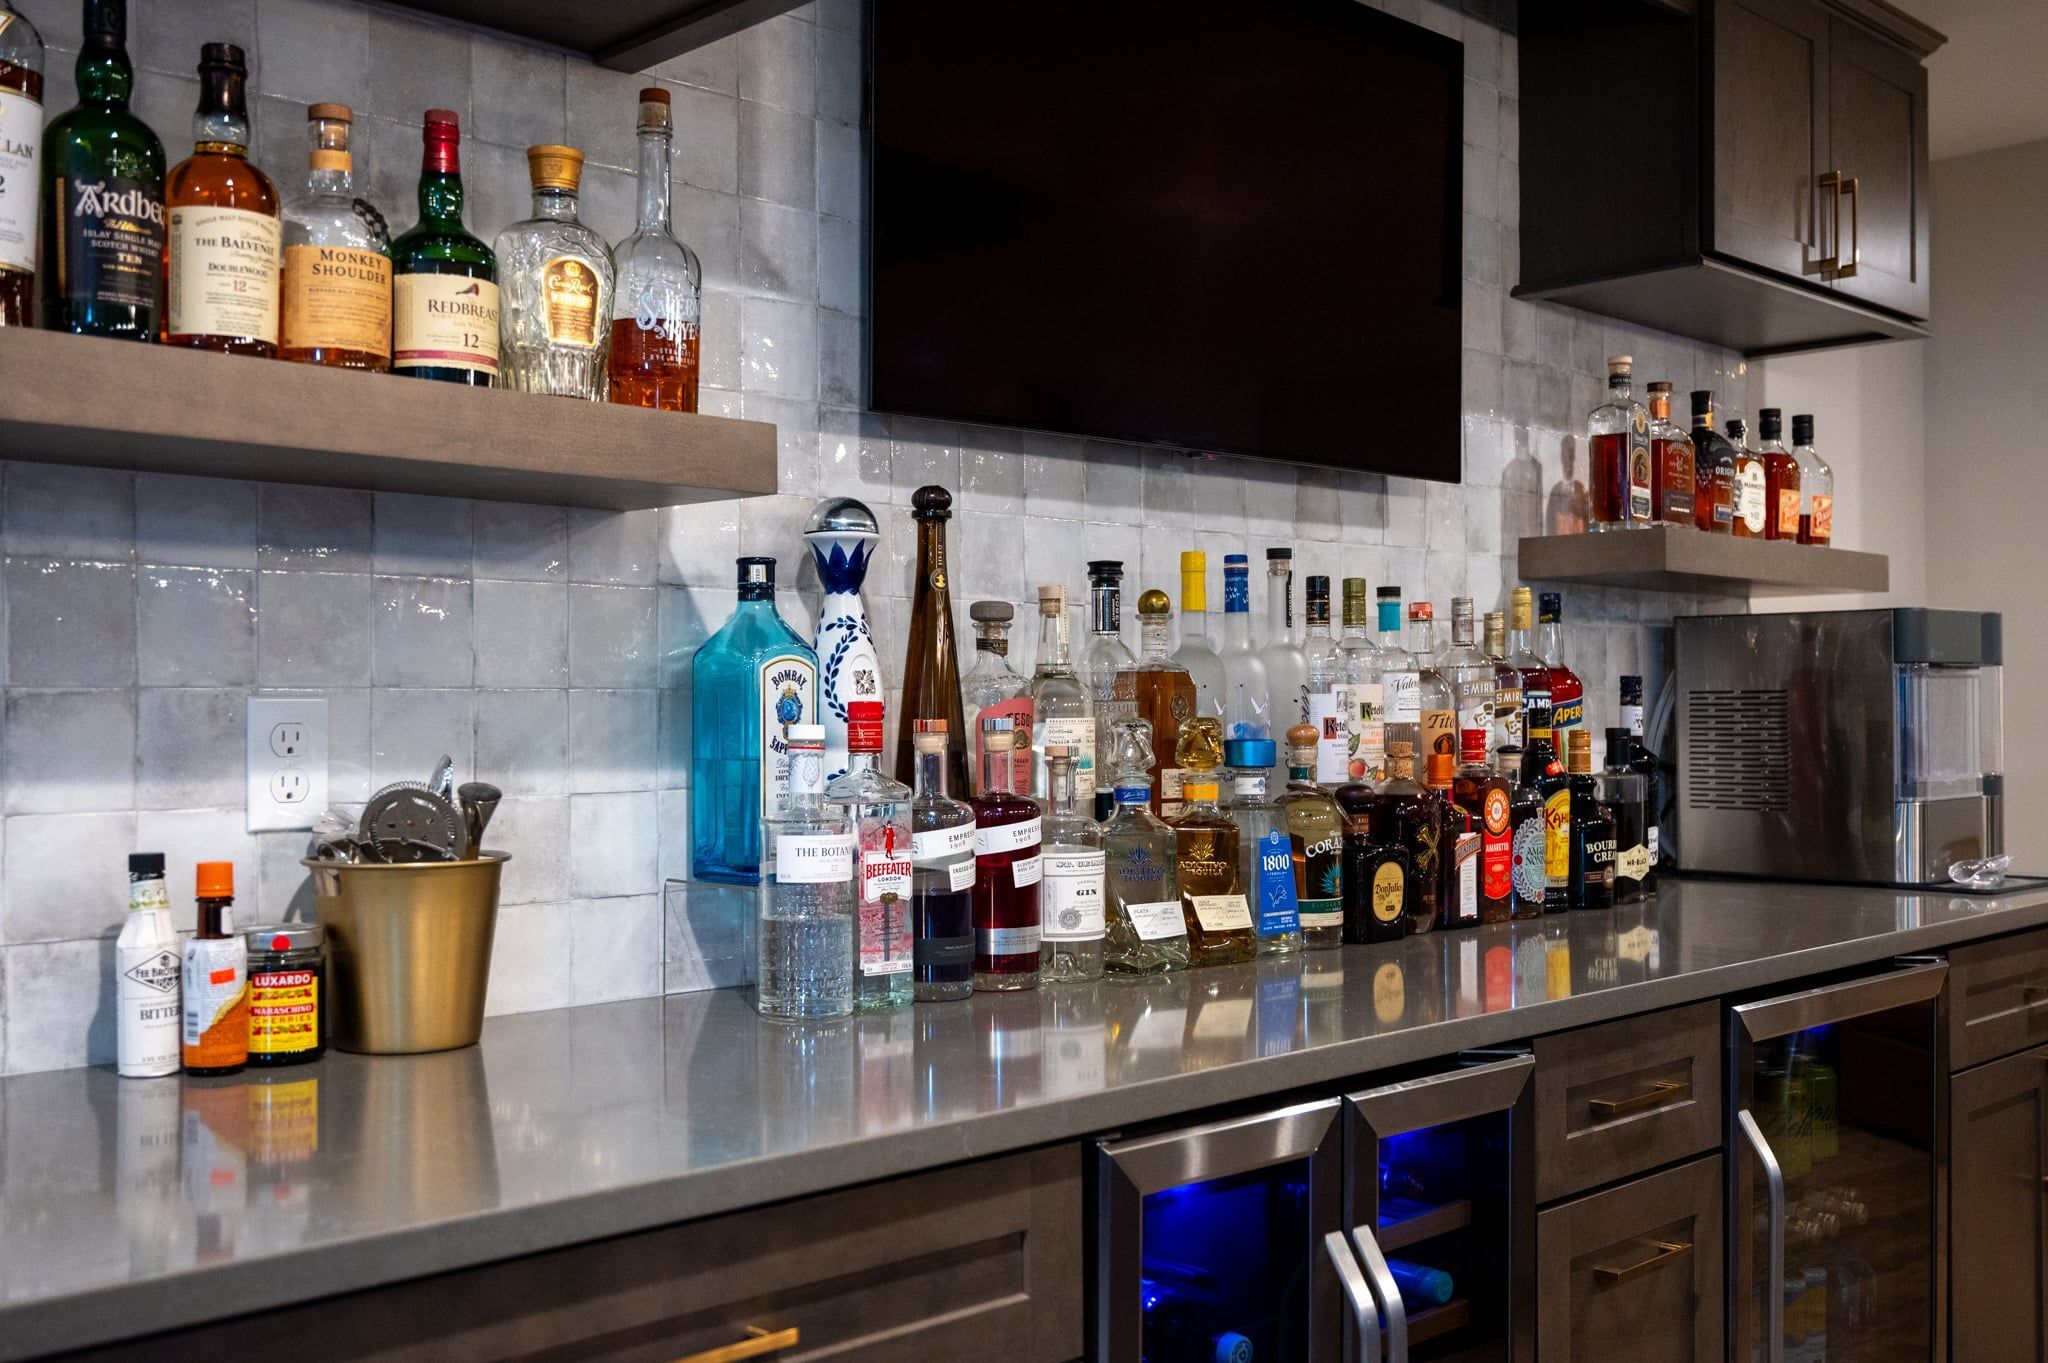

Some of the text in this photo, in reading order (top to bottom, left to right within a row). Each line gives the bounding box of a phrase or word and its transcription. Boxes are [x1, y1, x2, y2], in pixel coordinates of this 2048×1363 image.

[0, 139, 33, 159] LAN
[91, 240, 128, 250] SCOTCH
[195, 238, 217, 247] THE
[221, 236, 275, 257] BALVENIE
[117, 252, 142, 264] TEN
[320, 249, 383, 270] MONKEY
[312, 264, 386, 285] SHOULDER
[233, 280, 247, 292] 12
[428, 299, 498, 321] REDBREAST
[463, 333, 479, 349] 12
[771, 669, 807, 690] BOMBAY
[1496, 688, 1522, 704] SMIR
[770, 735, 788, 755] SAP
[1012, 824, 1040, 838] EMPRESS
[795, 847, 818, 857] THE
[1179, 861, 1227, 869] ADICTIVO
[1263, 854, 1290, 871] 1800
[866, 862, 911, 880] BEEFEATER
[1186, 868, 1223, 876] TEQUILA
[136, 966, 181, 978] FEE BROTHE
[255, 973, 311, 987] LUXARDO
[140, 1005, 183, 1021] BITTER
[254, 1014, 312, 1024] CHERRIES
